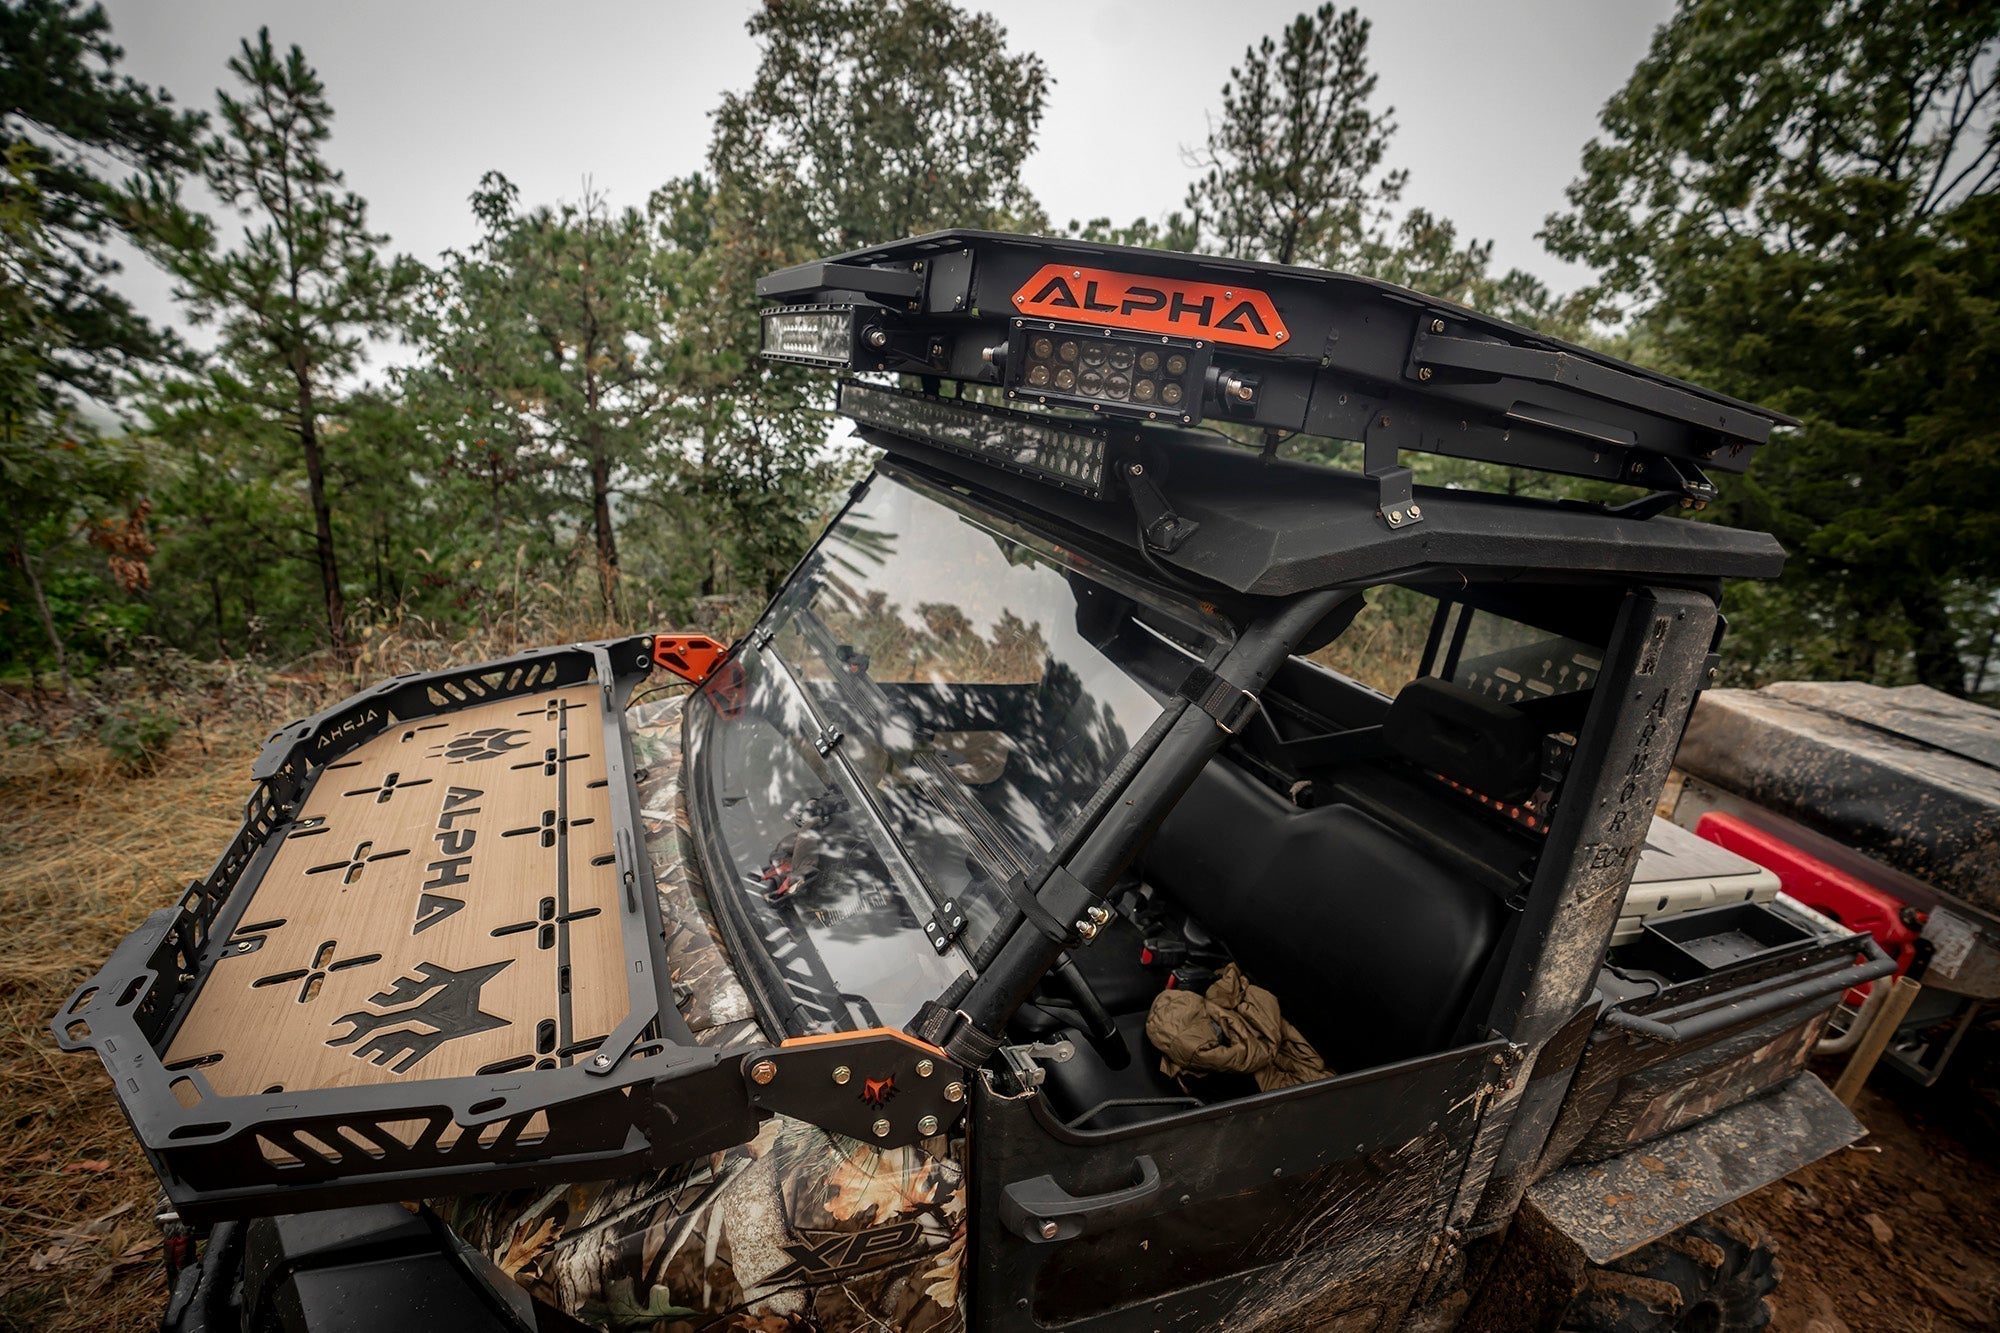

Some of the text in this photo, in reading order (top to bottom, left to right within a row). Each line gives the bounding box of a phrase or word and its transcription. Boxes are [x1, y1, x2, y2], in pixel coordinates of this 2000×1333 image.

[1031, 276, 1270, 335] ALPHA
[1609, 688, 1670, 833] ARMOR
[413, 786, 485, 936] ALPHA
[755, 1220, 925, 1287] XP
